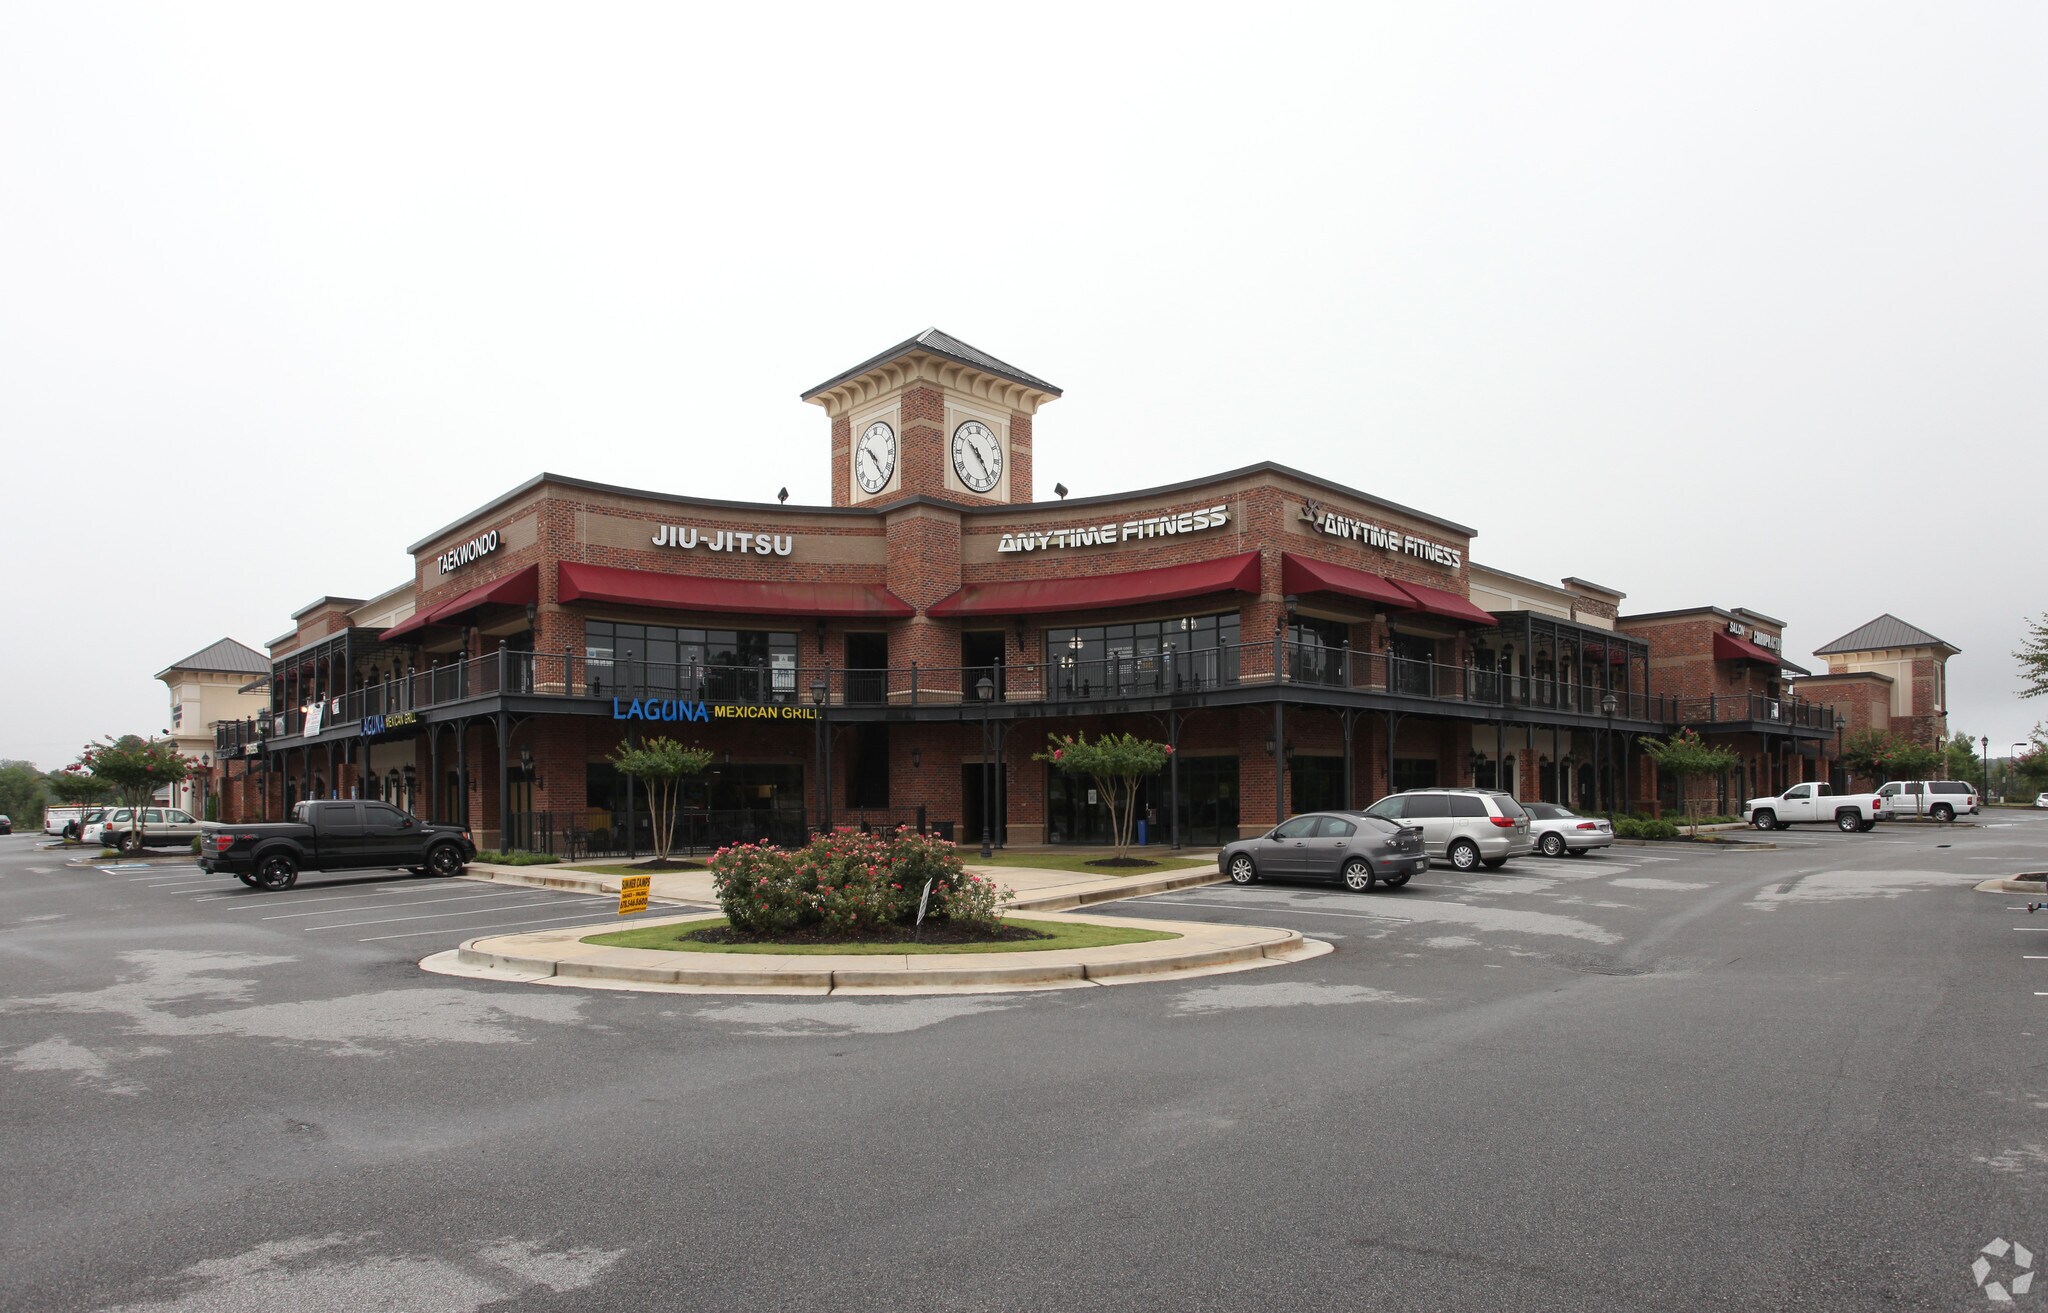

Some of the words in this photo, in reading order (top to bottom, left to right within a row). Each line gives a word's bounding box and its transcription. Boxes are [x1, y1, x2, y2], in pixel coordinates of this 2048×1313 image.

[651, 525, 793, 556] JIU-JITSU
[997, 523, 1117, 553] ANYTIME
[1121, 504, 1228, 542] FITNESS
[1324, 512, 1399, 552] ANYTIME
[1403, 535, 1462, 569] FITNESS
[437, 529, 498, 576] TAEKWONDO
[1729, 621, 1745, 636] SALON
[612, 695, 710, 723] LAGUNA
[714, 705, 778, 719] MEXICAN
[360, 714, 386, 737] LAGUNA
[637, 878, 650, 887] CAMPS
